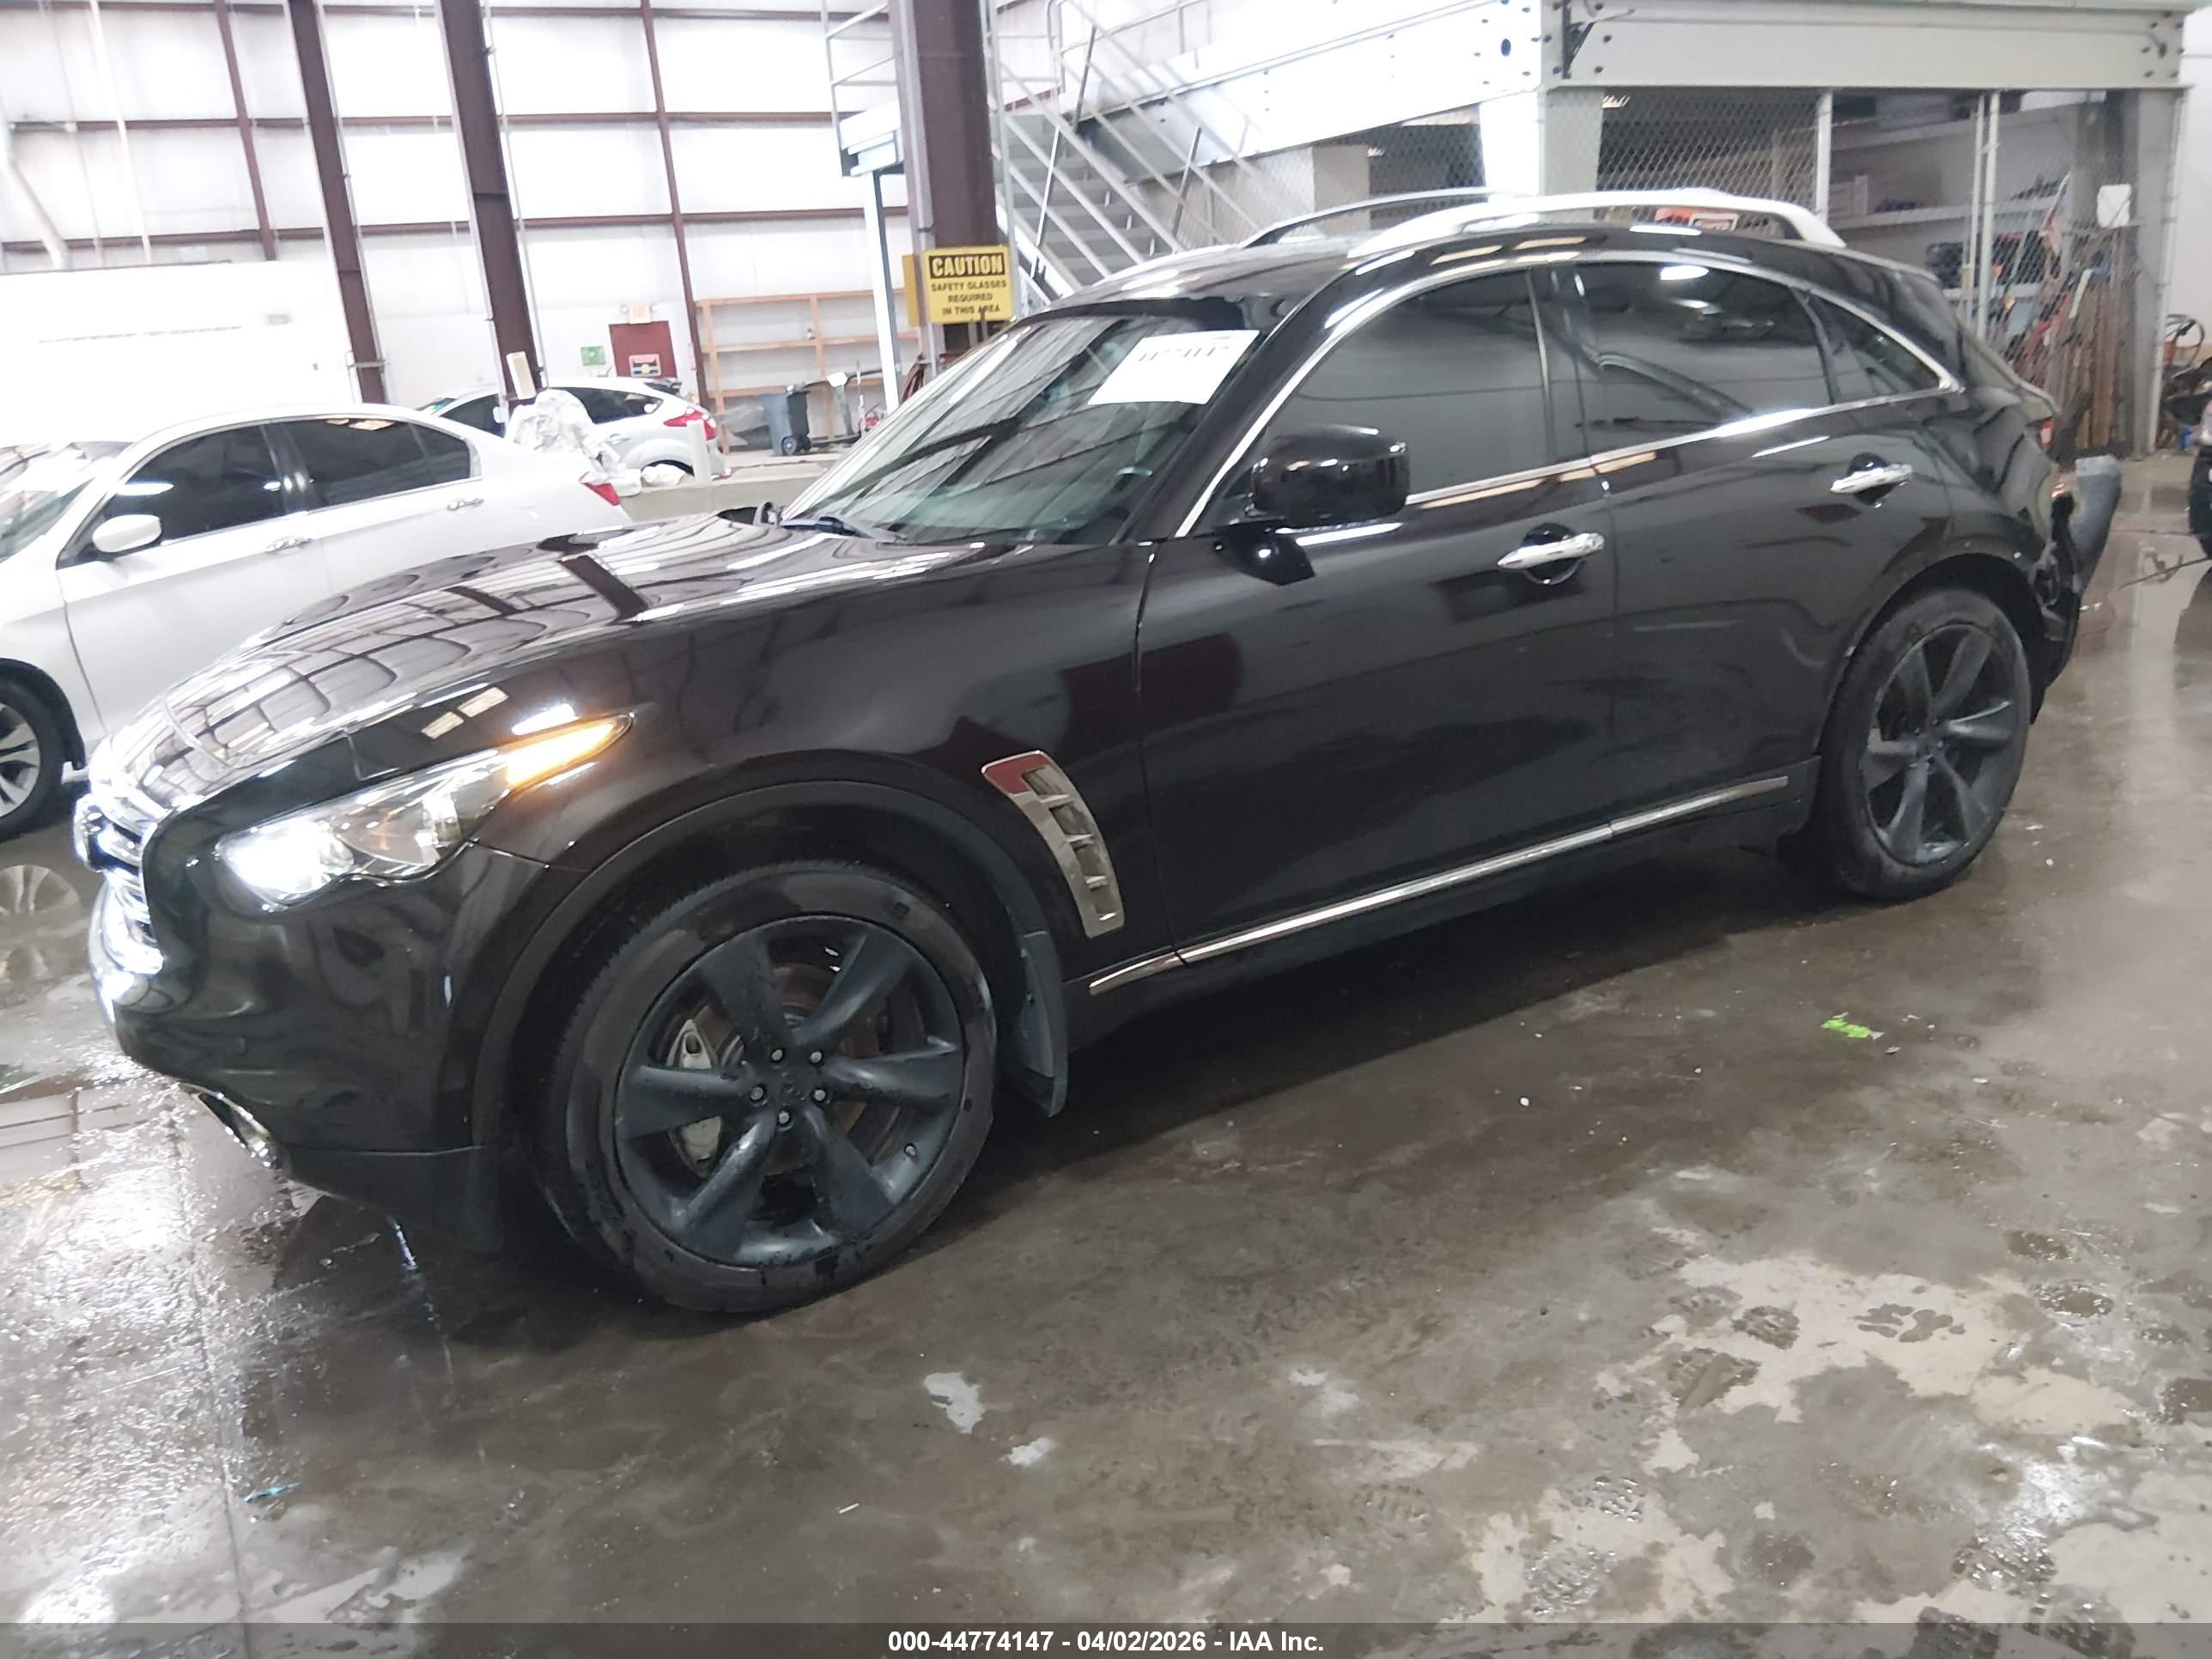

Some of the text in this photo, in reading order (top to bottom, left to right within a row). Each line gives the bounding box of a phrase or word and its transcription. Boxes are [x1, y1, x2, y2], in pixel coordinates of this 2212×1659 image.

[932, 255, 1003, 276] CAUTION
[931, 280, 1006, 292] SAFETY GLASSES
[947, 293, 993, 303] REQUIRED
[942, 307, 951, 315] IN
[955, 306, 975, 315] THIS
